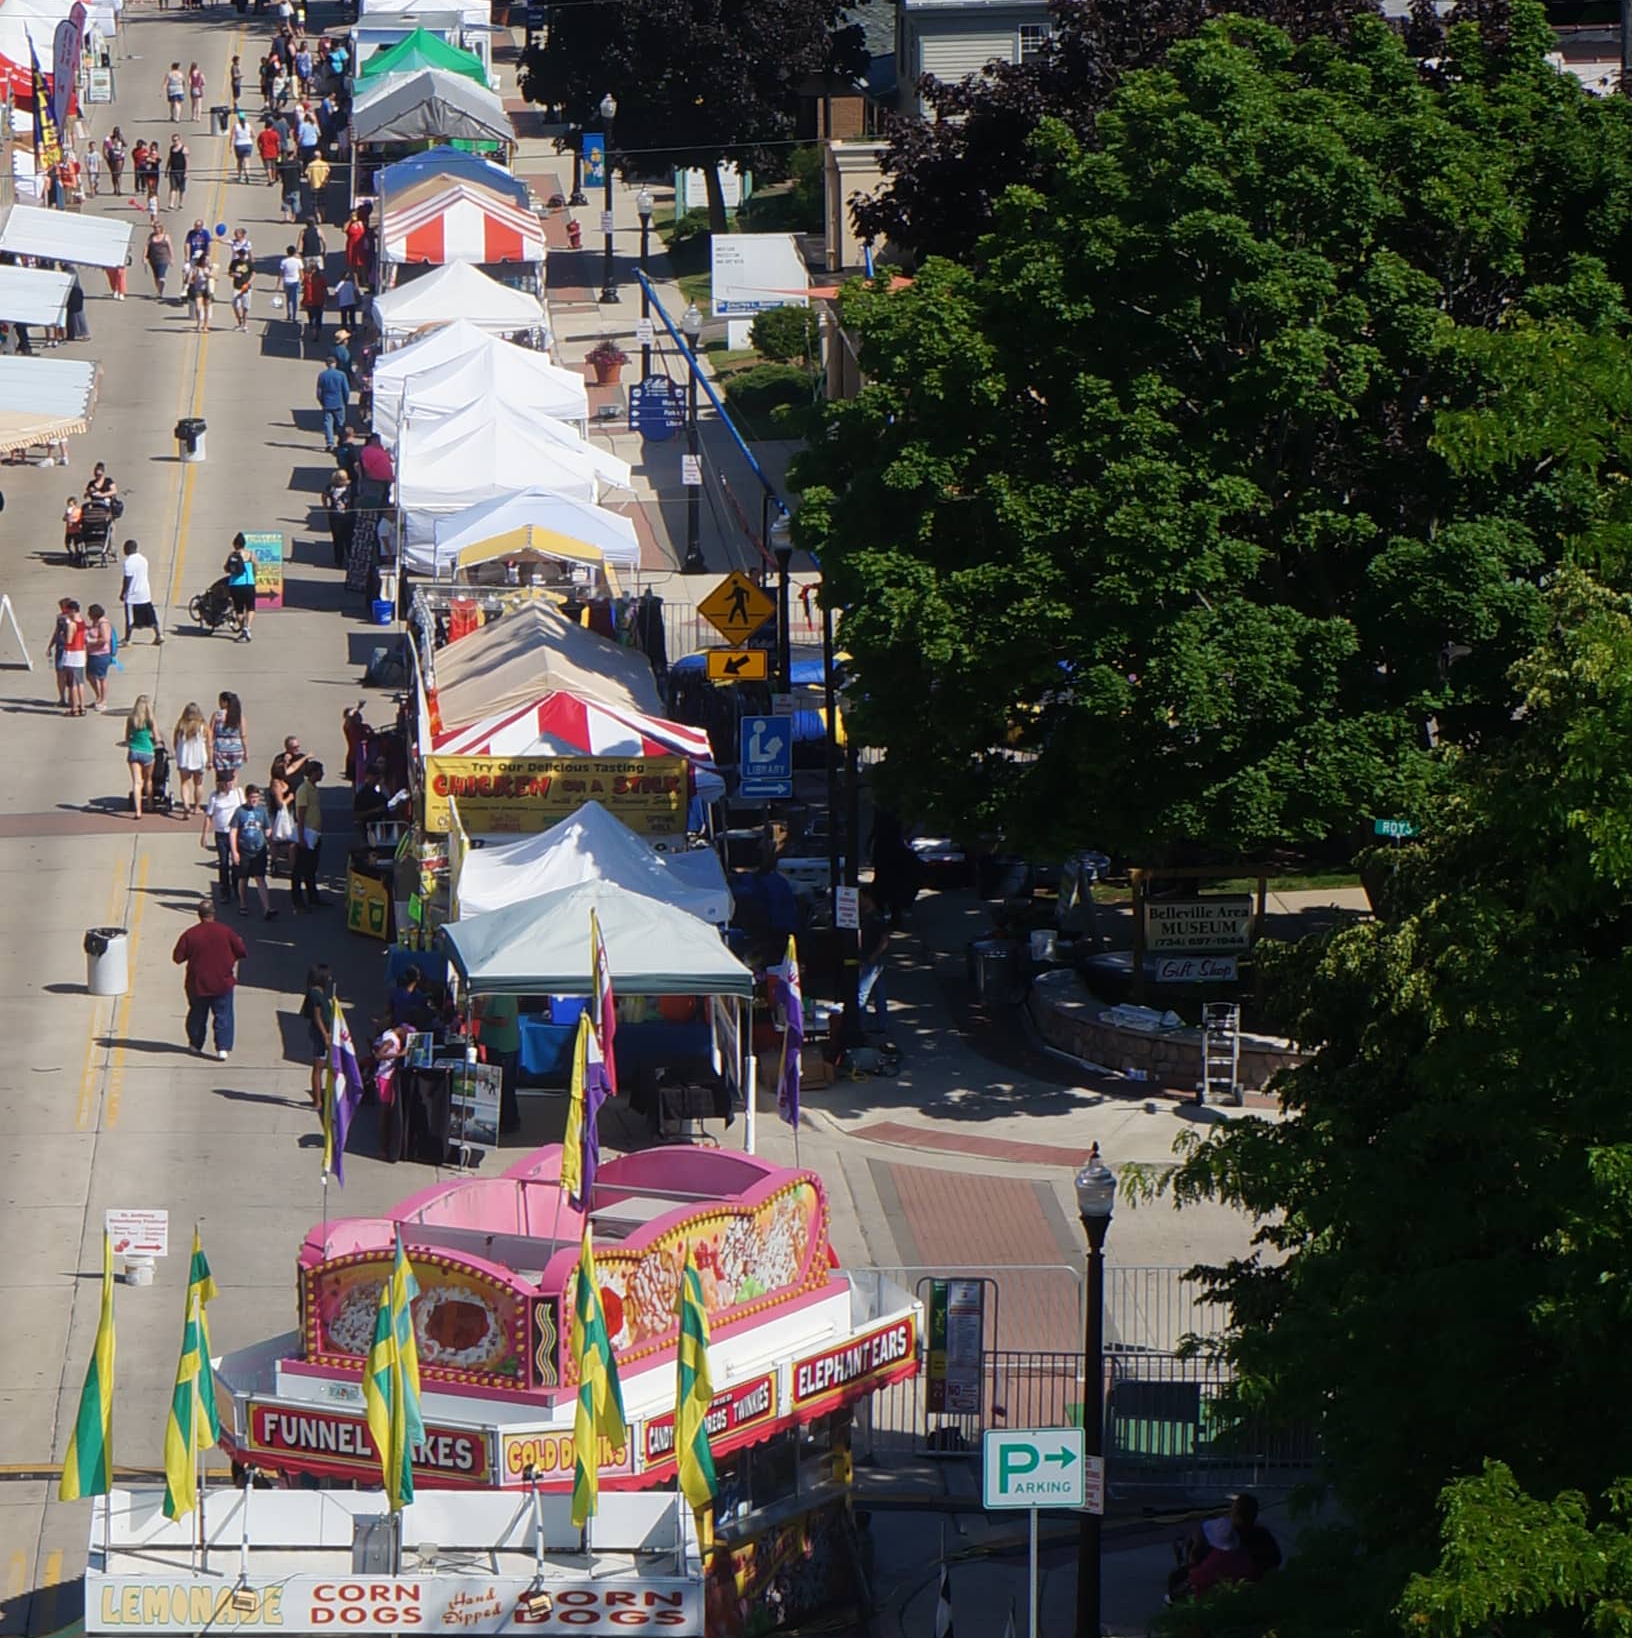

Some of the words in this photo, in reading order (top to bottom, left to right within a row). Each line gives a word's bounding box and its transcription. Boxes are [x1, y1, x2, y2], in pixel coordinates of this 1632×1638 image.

[472, 763, 492, 773] Try
[498, 763, 523, 773] Our
[528, 763, 589, 773] Delicious
[594, 763, 645, 774] Tasting
[747, 765, 785, 775] LIBRARY
[432, 774, 552, 799] CHICKEN
[612, 775, 682, 795] STICK
[1150, 907, 1213, 919] Belleville
[1218, 907, 1249, 917] Area
[1161, 921, 1238, 935] MUSEUM
[1162, 961, 1194, 978] Gift
[1199, 960, 1232, 979] Shop
[798, 1342, 870, 1397] ELEPHANT
[872, 1326, 907, 1364] EARS
[649, 1422, 674, 1455] CANDY
[733, 1381, 769, 1422] TWINKIES
[263, 1413, 372, 1456] FUNNEL
[507, 1438, 558, 1475] COLD
[314, 1584, 420, 1602] CORN
[449, 1588, 495, 1610] Hand
[311, 1607, 422, 1625] DOGS
[442, 1603, 501, 1627] Dipped
[514, 1609, 685, 1625] DOGS
